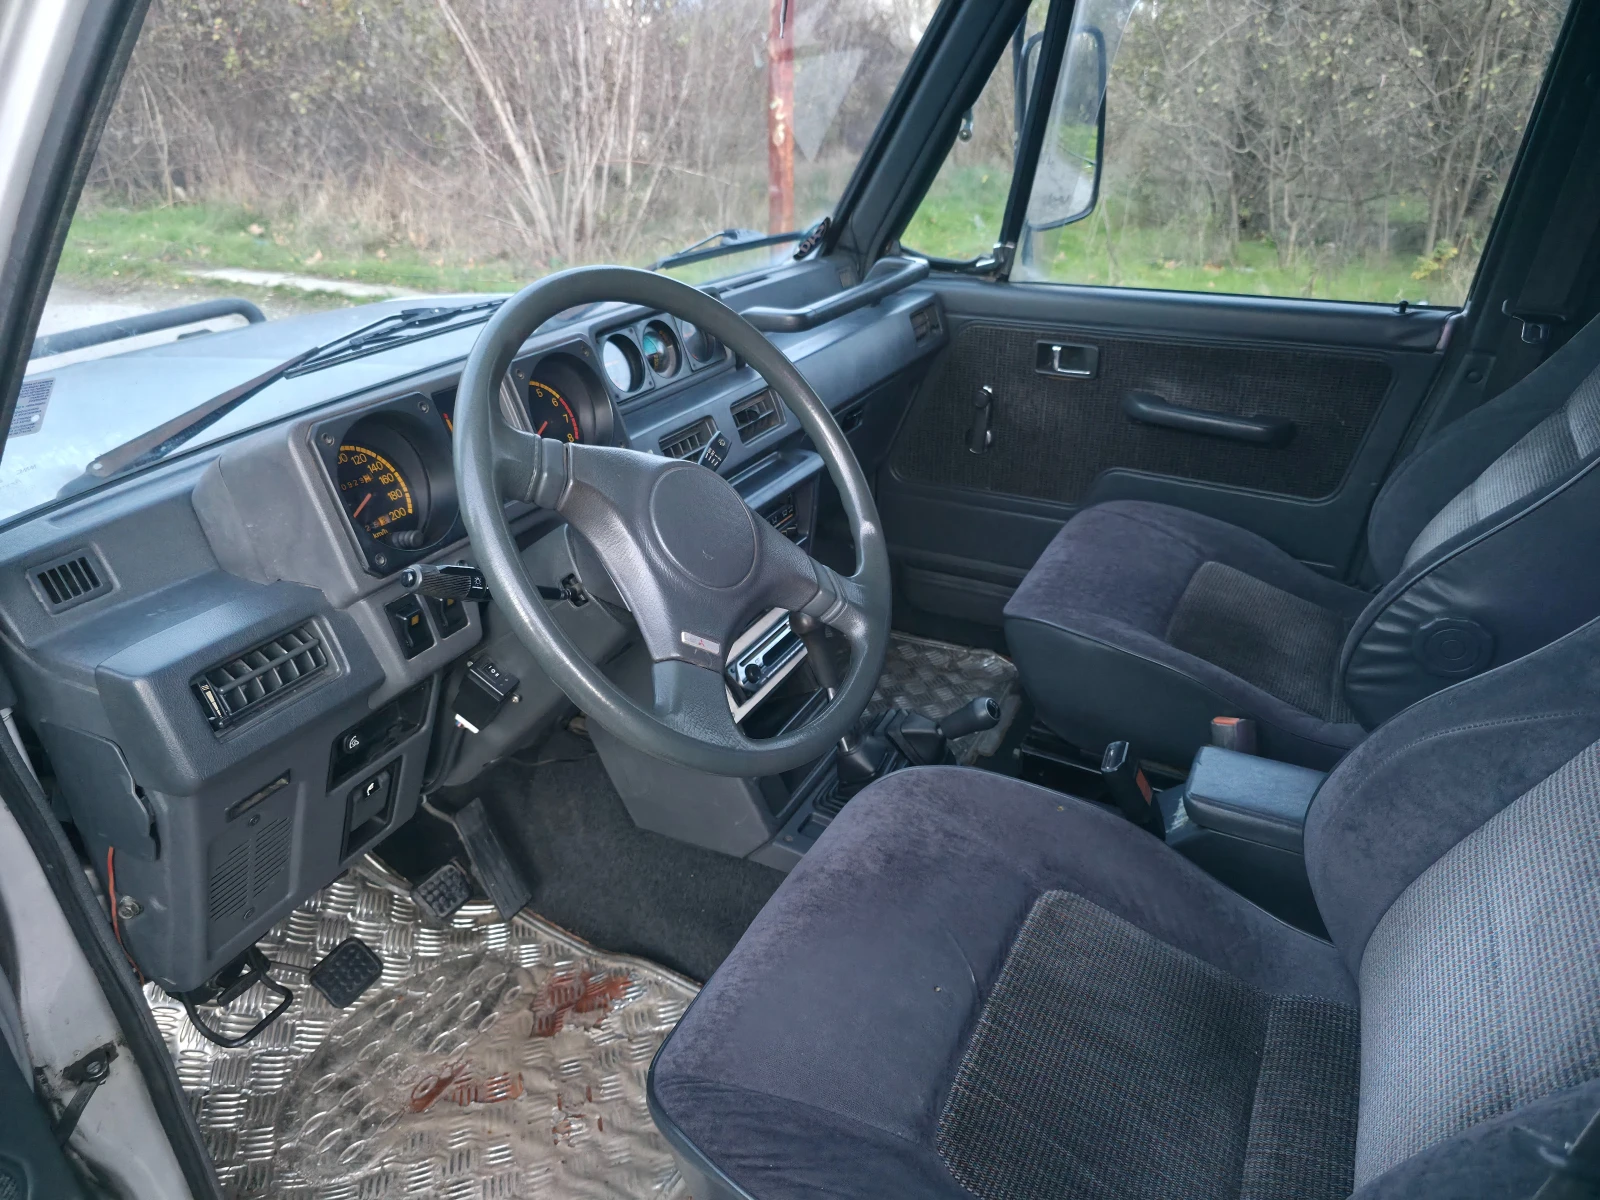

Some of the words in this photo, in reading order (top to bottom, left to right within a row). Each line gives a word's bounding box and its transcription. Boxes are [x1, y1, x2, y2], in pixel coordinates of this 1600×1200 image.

[535, 388, 543, 398] 5
[551, 397, 559, 407] 6
[562, 413, 569, 423] 7
[567, 433, 574, 442] 8
[351, 453, 367, 466] 120
[367, 461, 383, 474] 140
[378, 473, 394, 485] 160
[387, 489, 402, 501] 180
[388, 507, 407, 521] 200
[372, 528, 388, 539] km/h
